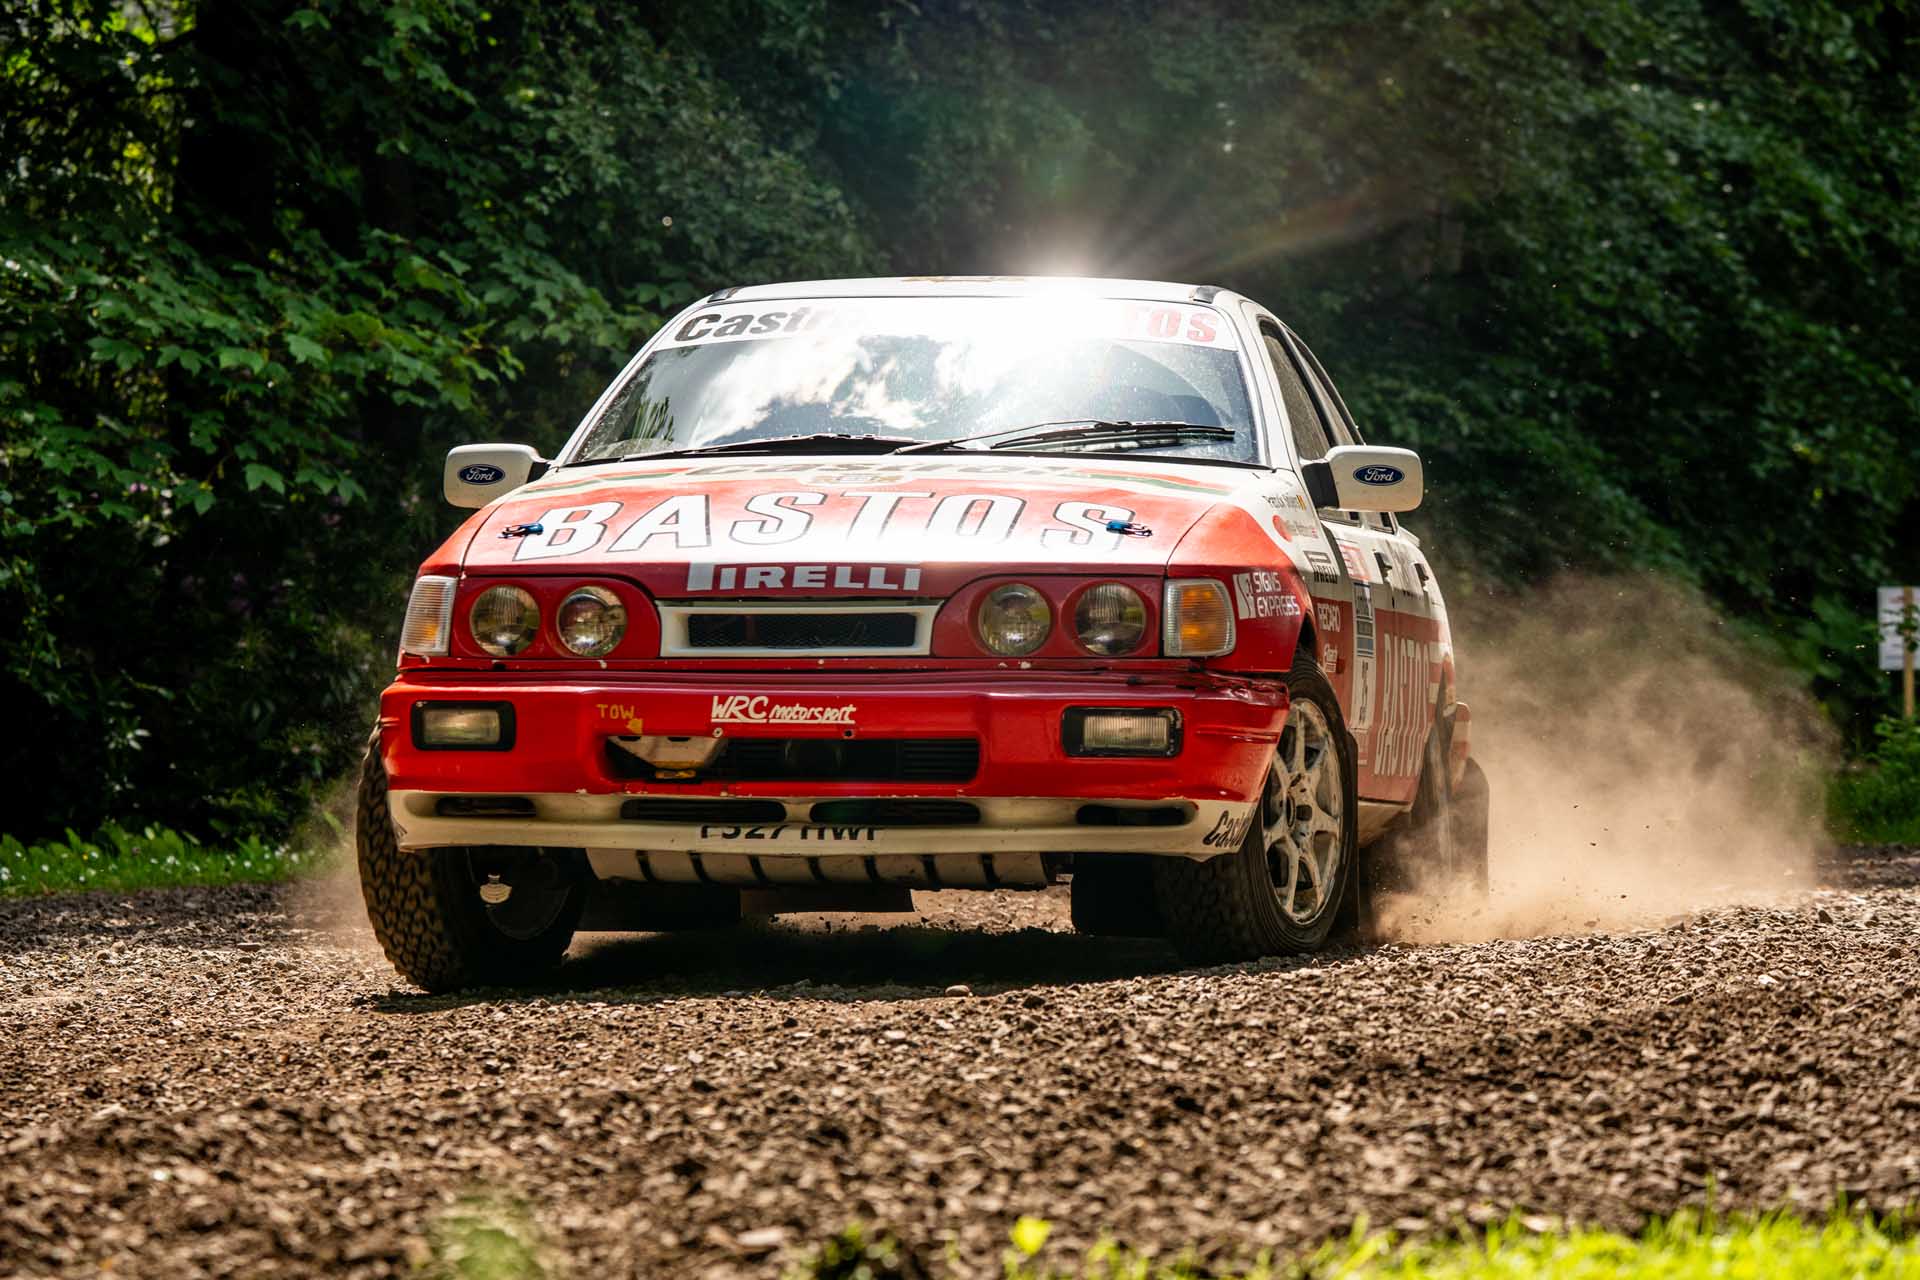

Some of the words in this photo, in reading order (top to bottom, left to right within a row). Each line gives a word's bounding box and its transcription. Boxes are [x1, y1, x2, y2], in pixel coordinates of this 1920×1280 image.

[674, 306, 836, 342] Castr
[1122, 305, 1218, 343] TOS
[465, 467, 494, 483] Ford
[1364, 467, 1395, 483] Ford
[513, 490, 1133, 562] BASTOS
[1252, 571, 1281, 593] SIGNS
[1257, 596, 1301, 618] EXPRESS
[597, 703, 635, 719] TOW
[711, 696, 769, 722] WRC
[769, 703, 856, 723] motorsport
